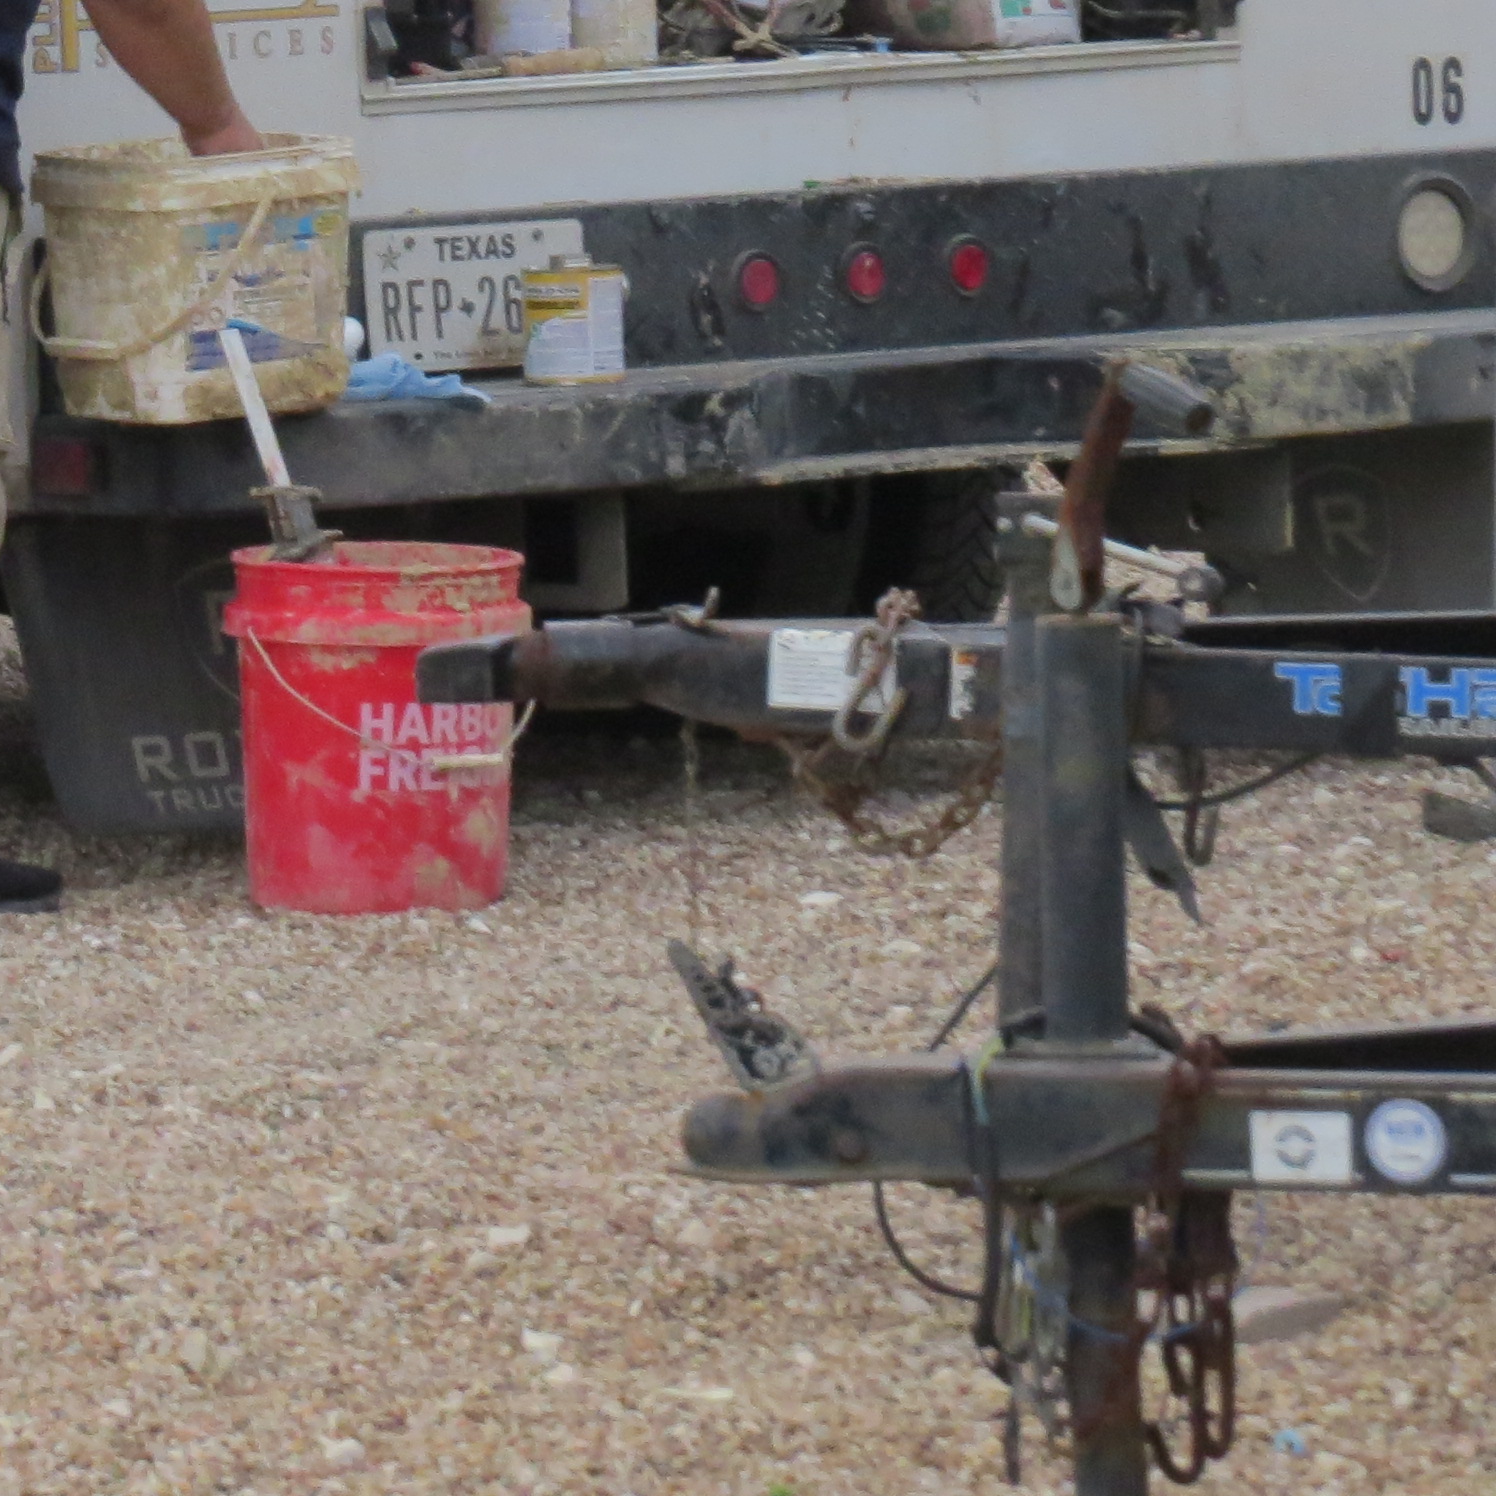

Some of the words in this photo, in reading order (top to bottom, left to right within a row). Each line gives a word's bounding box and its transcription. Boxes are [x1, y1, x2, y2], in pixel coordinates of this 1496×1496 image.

[1412, 56, 1464, 126] 06
[434, 233, 516, 262] TEXAS
[478, 274, 525, 337] 26
[131, 730, 243, 782] RO
